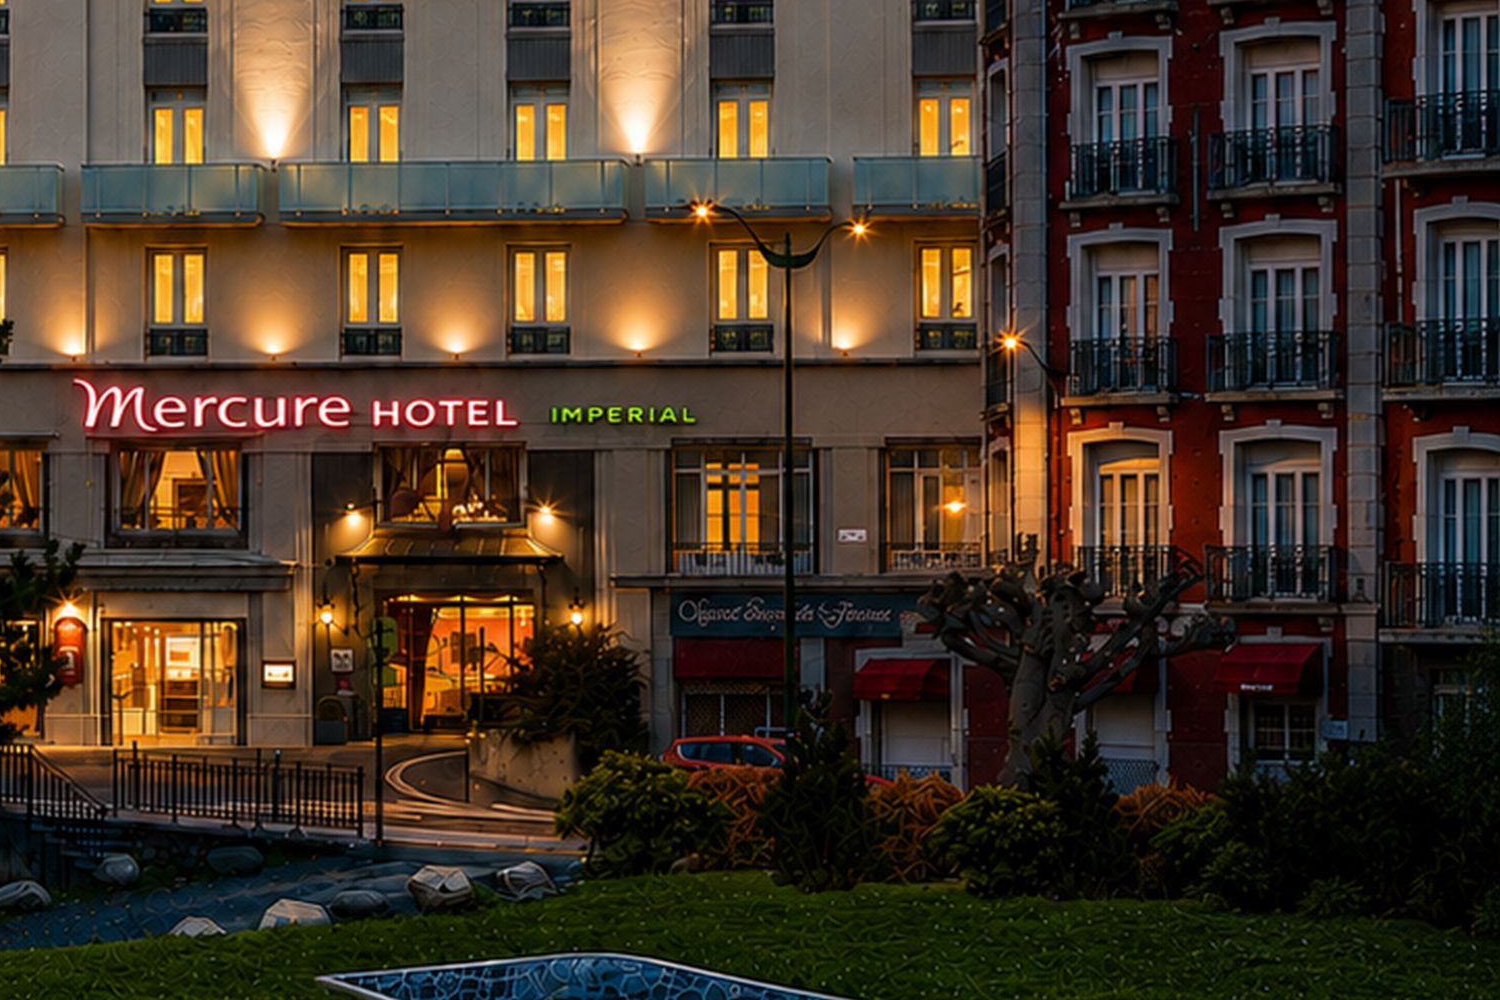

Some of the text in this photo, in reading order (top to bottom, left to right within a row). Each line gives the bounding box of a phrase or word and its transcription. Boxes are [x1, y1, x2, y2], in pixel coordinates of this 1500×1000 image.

[73, 378, 696, 432] Mercure HOTEL IMPERIAL
